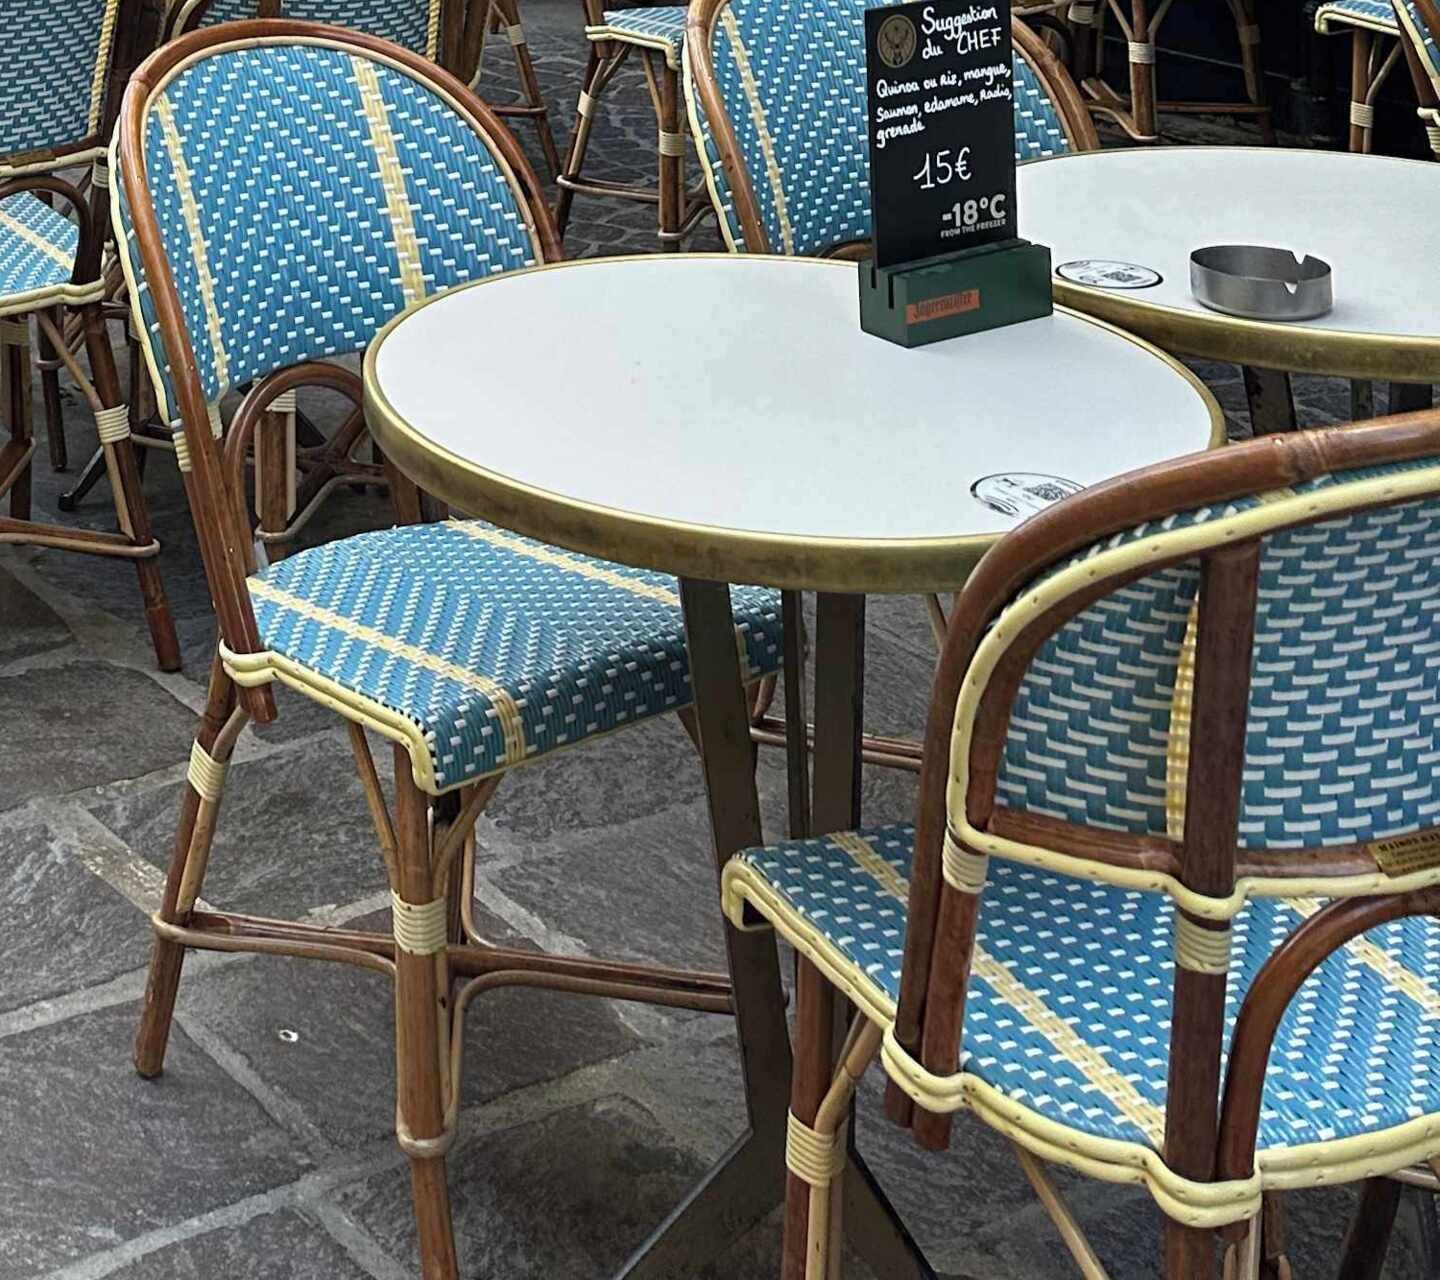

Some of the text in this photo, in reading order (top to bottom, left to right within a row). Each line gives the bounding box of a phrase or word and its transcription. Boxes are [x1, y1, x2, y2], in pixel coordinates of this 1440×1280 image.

[920, 5, 999, 42] Suggestion
[922, 28, 1002, 60] du CHEF
[876, 78, 920, 100] Quinoa
[923, 76, 937, 90] ou
[913, 146, 973, 190] 15€
[941, 194, 1007, 228] -18°C
[940, 218, 1007, 239] FROM THE FREEZER
